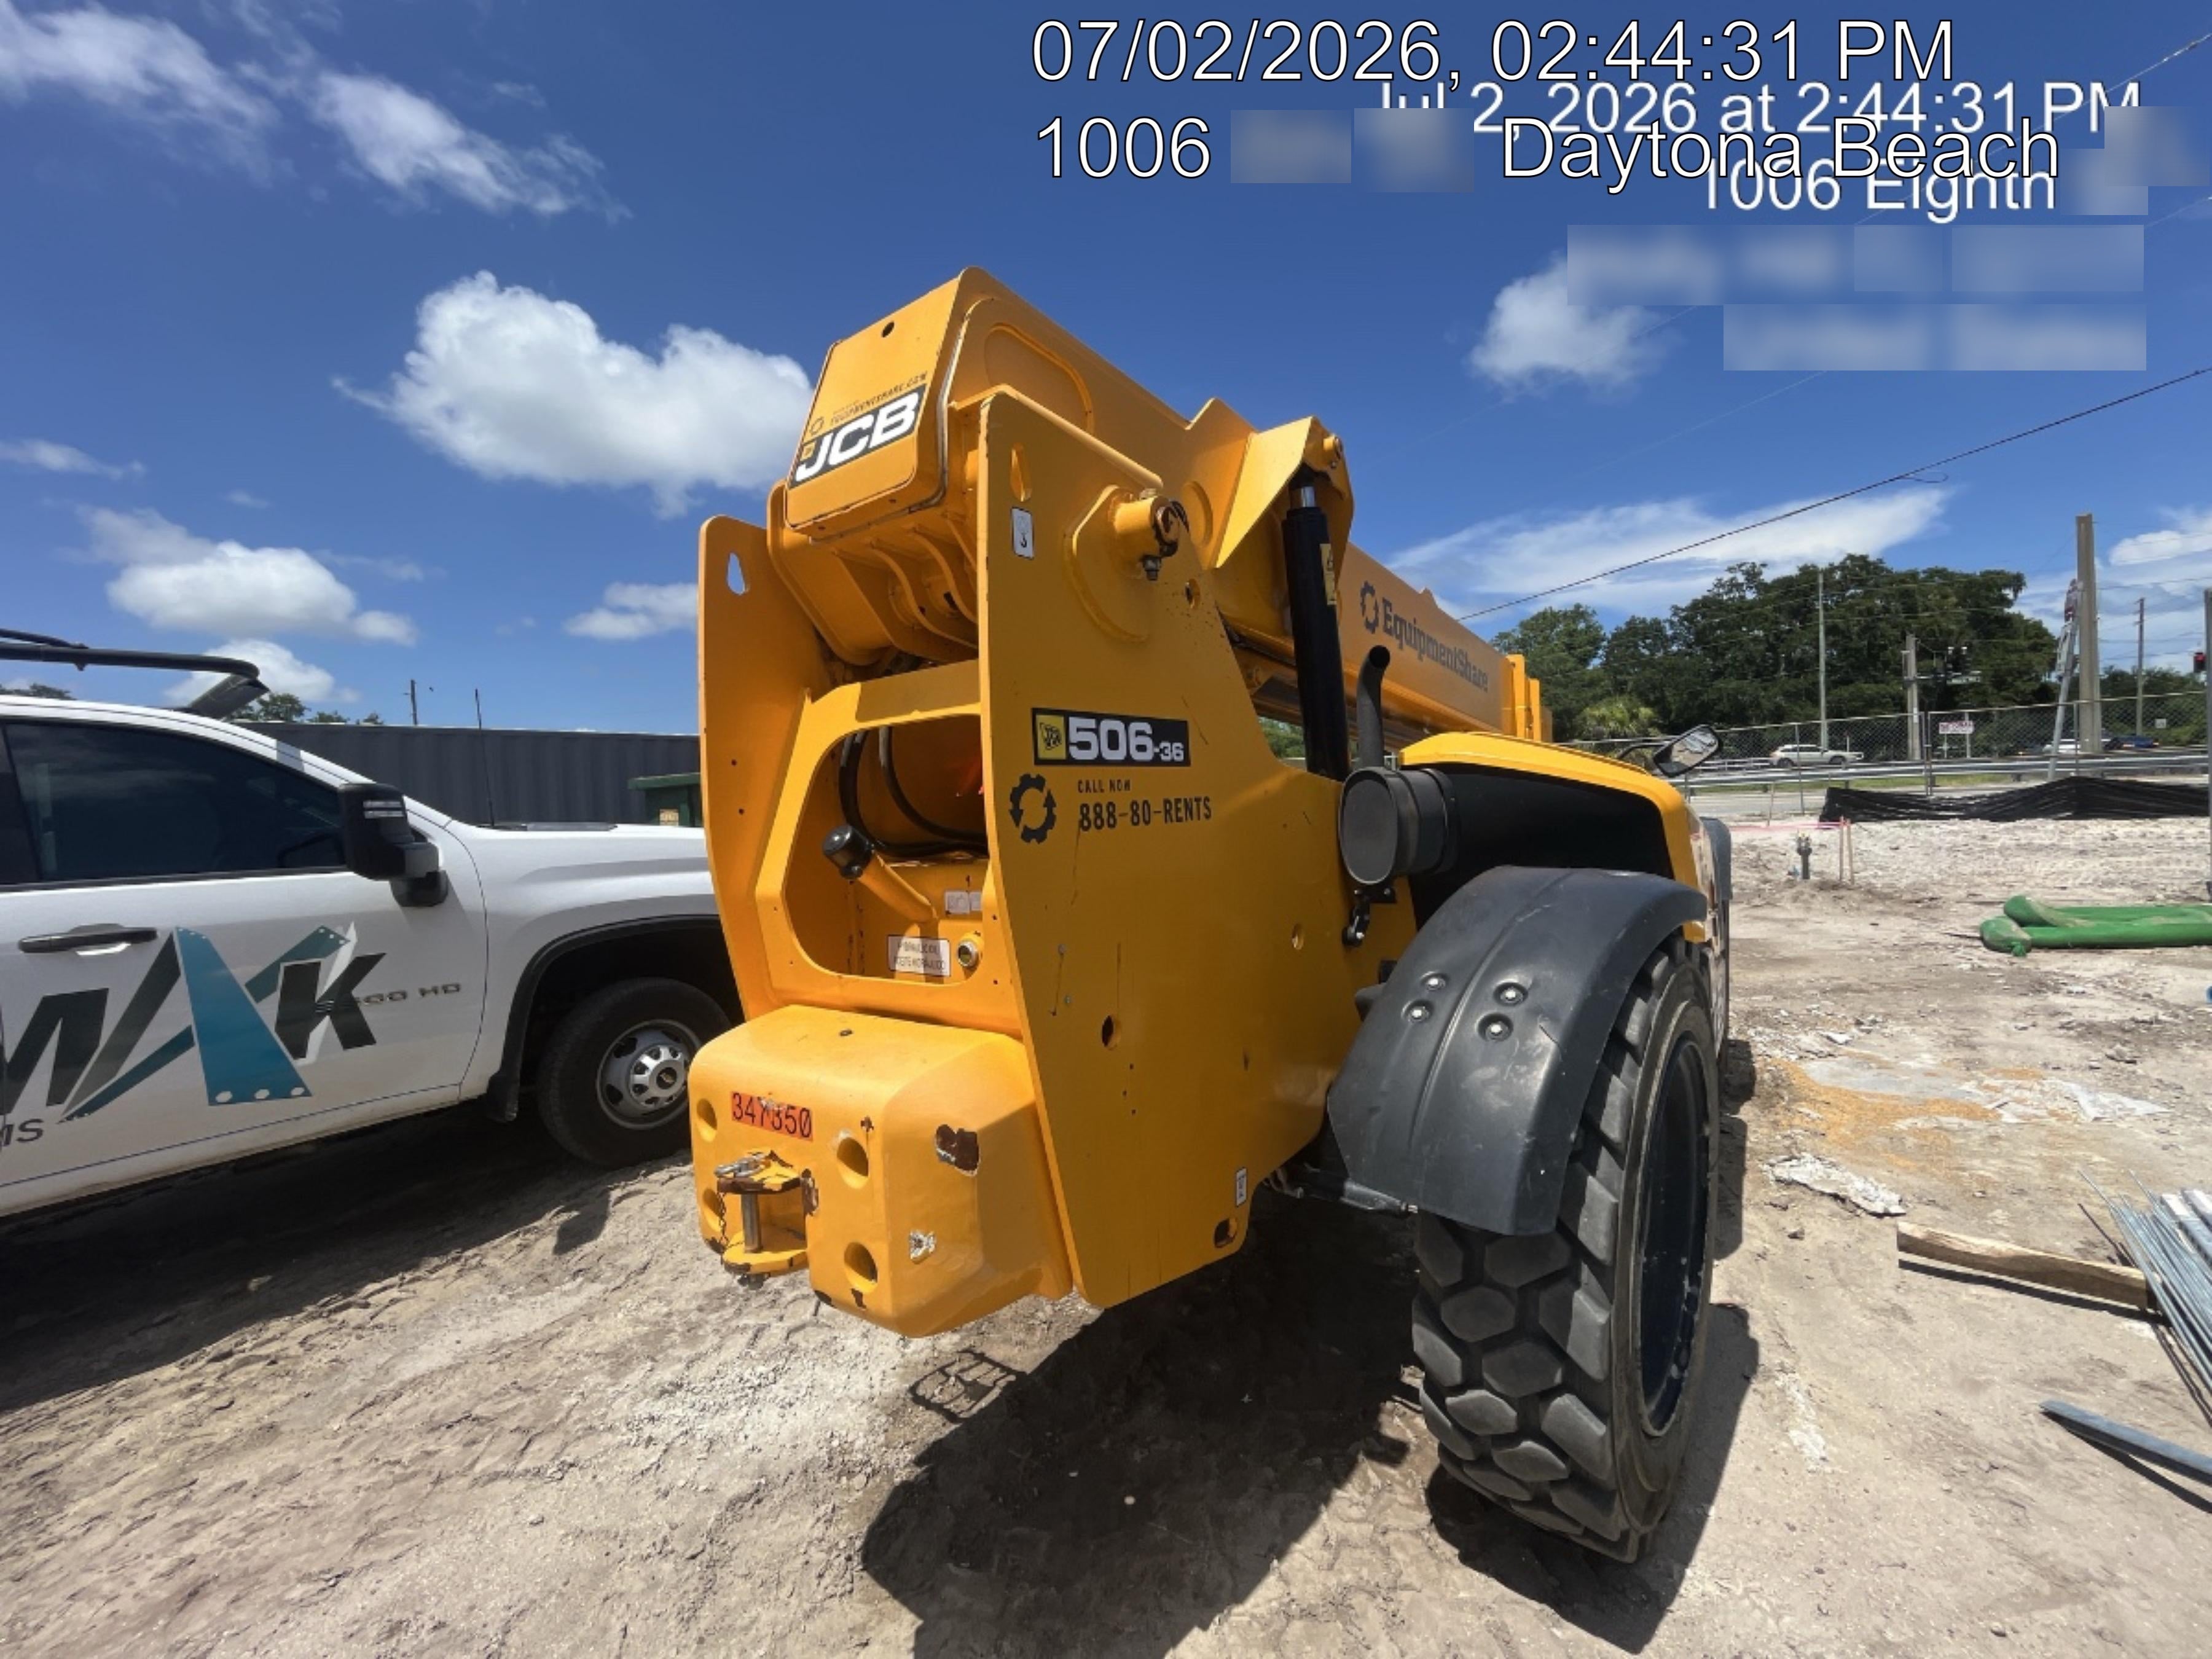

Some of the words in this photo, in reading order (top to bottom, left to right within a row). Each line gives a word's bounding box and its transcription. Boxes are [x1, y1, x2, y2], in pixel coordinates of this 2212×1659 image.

[795, 391, 920, 482] JCB
[1382, 596, 1488, 692] EquipmentShare
[1069, 716, 1185, 762] 506-36
[1077, 779, 1104, 794] CALL
[1109, 779, 1131, 791] NOW
[1078, 796, 1212, 832] 888-80-RENTS
